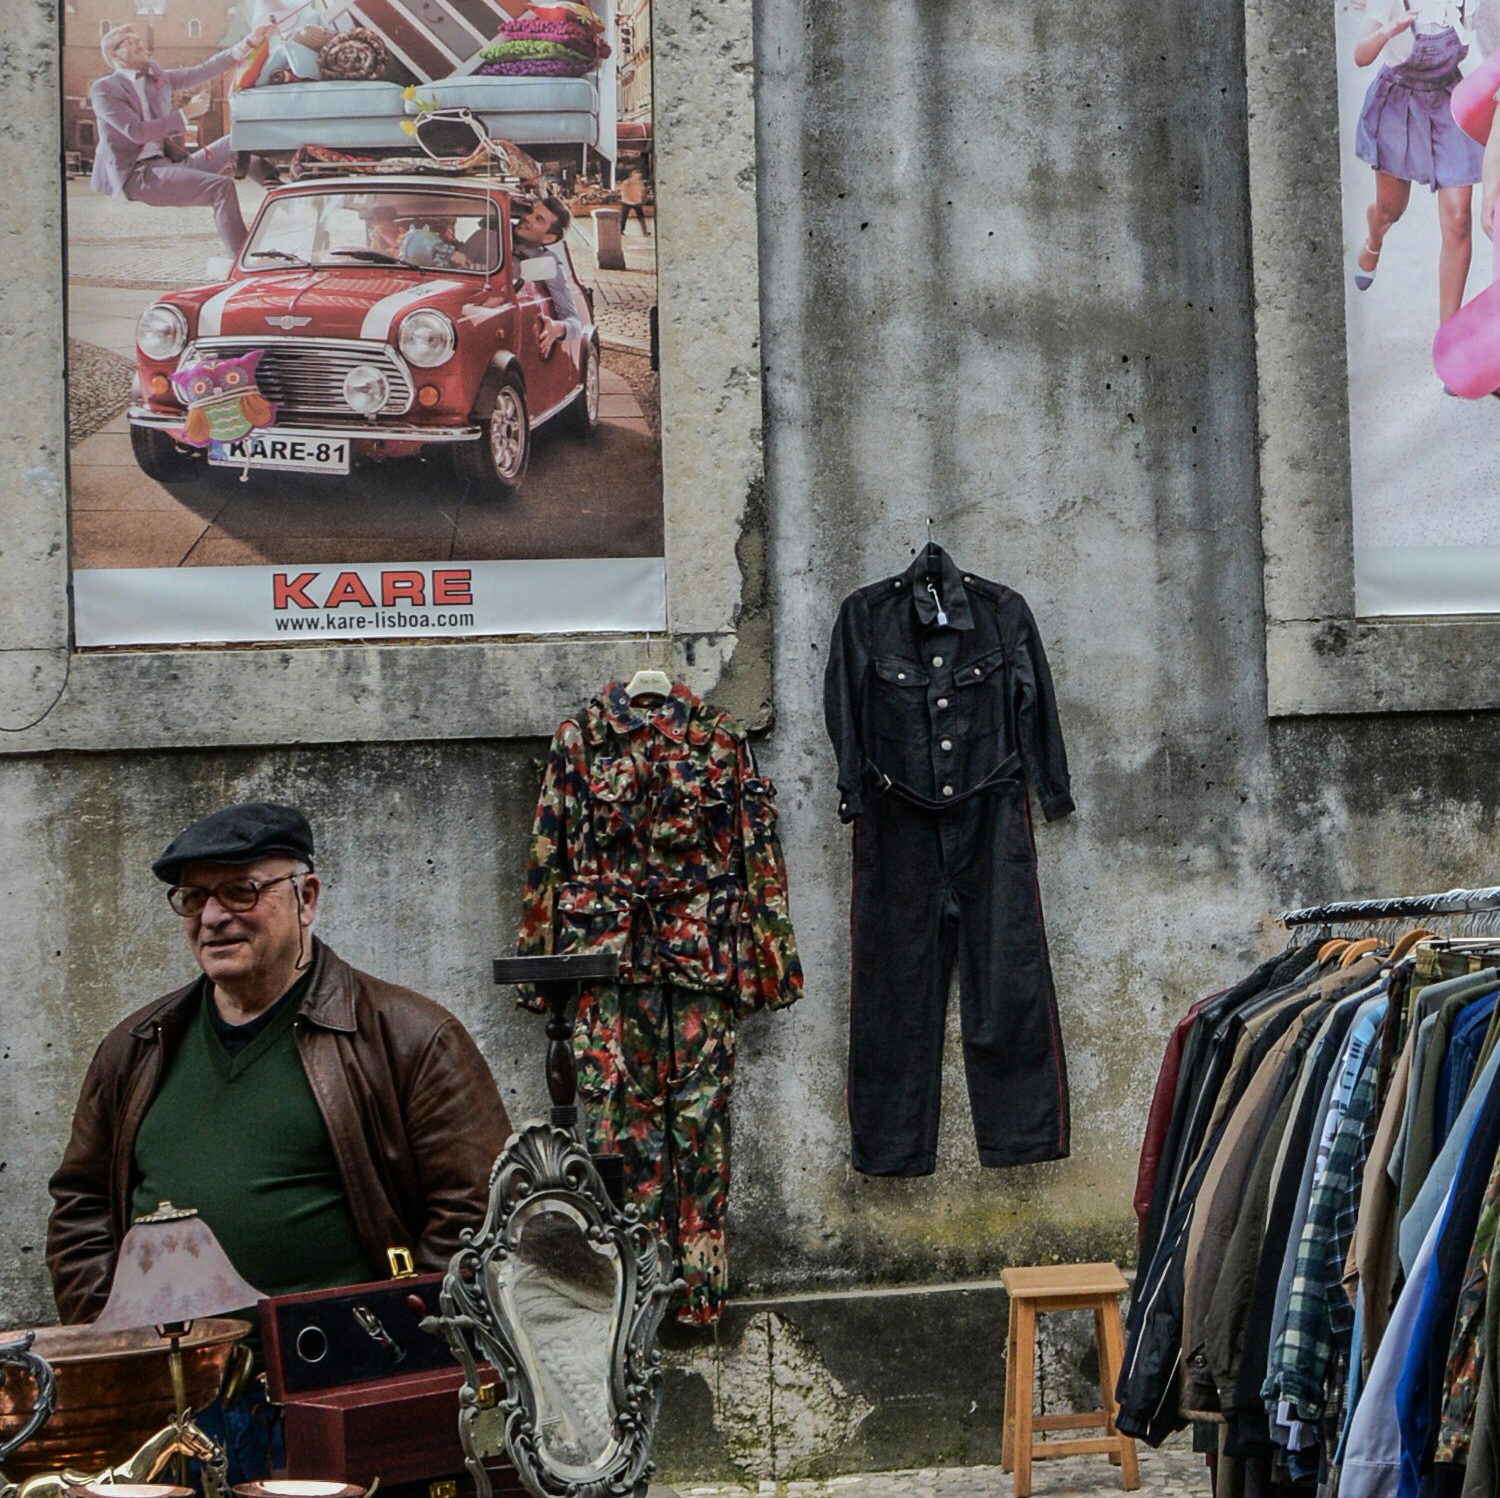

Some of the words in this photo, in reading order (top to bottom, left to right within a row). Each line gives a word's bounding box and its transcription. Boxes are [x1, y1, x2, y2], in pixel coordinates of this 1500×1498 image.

[229, 440, 345, 464] KARE-81
[272, 569, 474, 610] KARE
[275, 611, 475, 631] www.kare-lisboa.com
